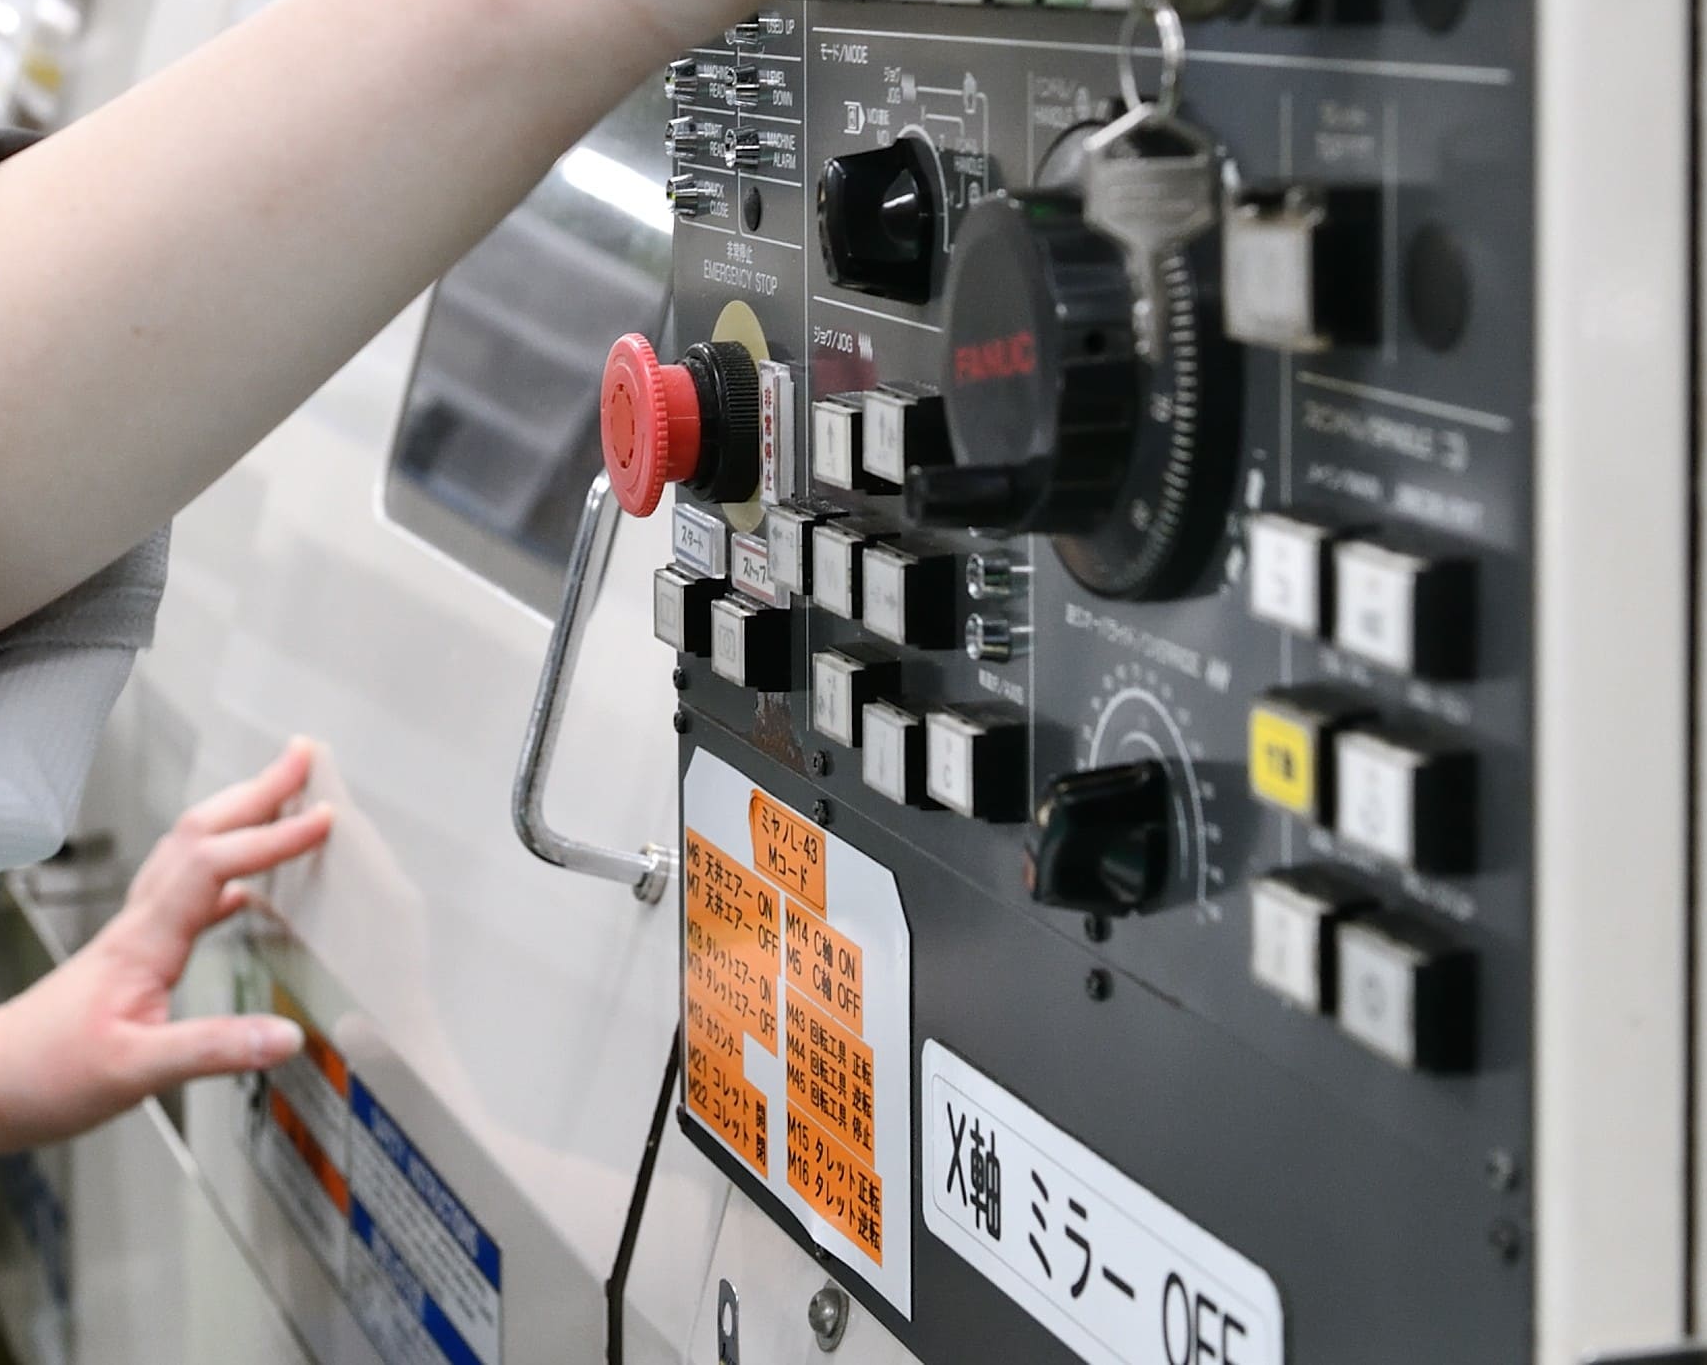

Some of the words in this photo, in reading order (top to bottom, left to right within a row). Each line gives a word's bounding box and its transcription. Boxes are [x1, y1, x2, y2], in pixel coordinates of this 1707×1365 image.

[766, 19, 784, 35] USED
[786, 20, 795, 35] UP
[820, 43, 868, 65] モード/MODE
[709, 83, 725, 98] READ
[772, 90, 793, 106] DOWN
[886, 87, 901, 104] JOG
[710, 141, 725, 158] READ
[773, 153, 796, 169] ALARM
[709, 201, 729, 218] CLOSE
[727, 240, 754, 265] 非常停止
[703, 258, 753, 290] EMERGENCY
[756, 271, 778, 296] STOP
[814, 325, 854, 354] ジョグ/JOG
[680, 524, 704, 553] スタート
[761, 805, 818, 865] ミヤノL-43
[686, 837, 700, 868] M6
[705, 850, 753, 899] 天井エアー
[758, 890, 773, 923] ON
[768, 846, 808, 892] Mコード
[686, 867, 700, 899] M7
[705, 882, 753, 931] 天井エアー
[758, 923, 779, 958] OFF
[786, 907, 809, 947] M14
[814, 929, 833, 969] C軸
[838, 947, 855, 983] ON
[706, 932, 756, 985] タレットエアー
[760, 974, 772, 1006] ON
[786, 941, 802, 976] M5
[812, 962, 833, 1003] C軸
[837, 981, 861, 1019] OFF
[706, 965, 756, 1018] タレットエアー
[760, 1007, 776, 1041] OFF
[706, 1012, 742, 1058] カウンター
[786, 999, 806, 1033] M43
[810, 1018, 847, 1069] 回転工具
[852, 1050, 871, 1087] 正転
[687, 1039, 707, 1078] M21
[713, 1066, 750, 1116] コレット
[786, 1030, 806, 1063] M44
[810, 1048, 847, 1102] 回転工具
[852, 1081, 871, 1120] 逆転
[687, 1071, 708, 1110] M22
[713, 1098, 750, 1148] コレット
[786, 1060, 806, 1095] M45
[810, 1079, 847, 1132] 回転工具
[852, 1113, 872, 1152] 停止
[787, 1110, 810, 1153] M15
[787, 1144, 810, 1187] M16
[946, 1100, 1002, 1242] X軸
[1028, 1168, 1136, 1301] ミラー
